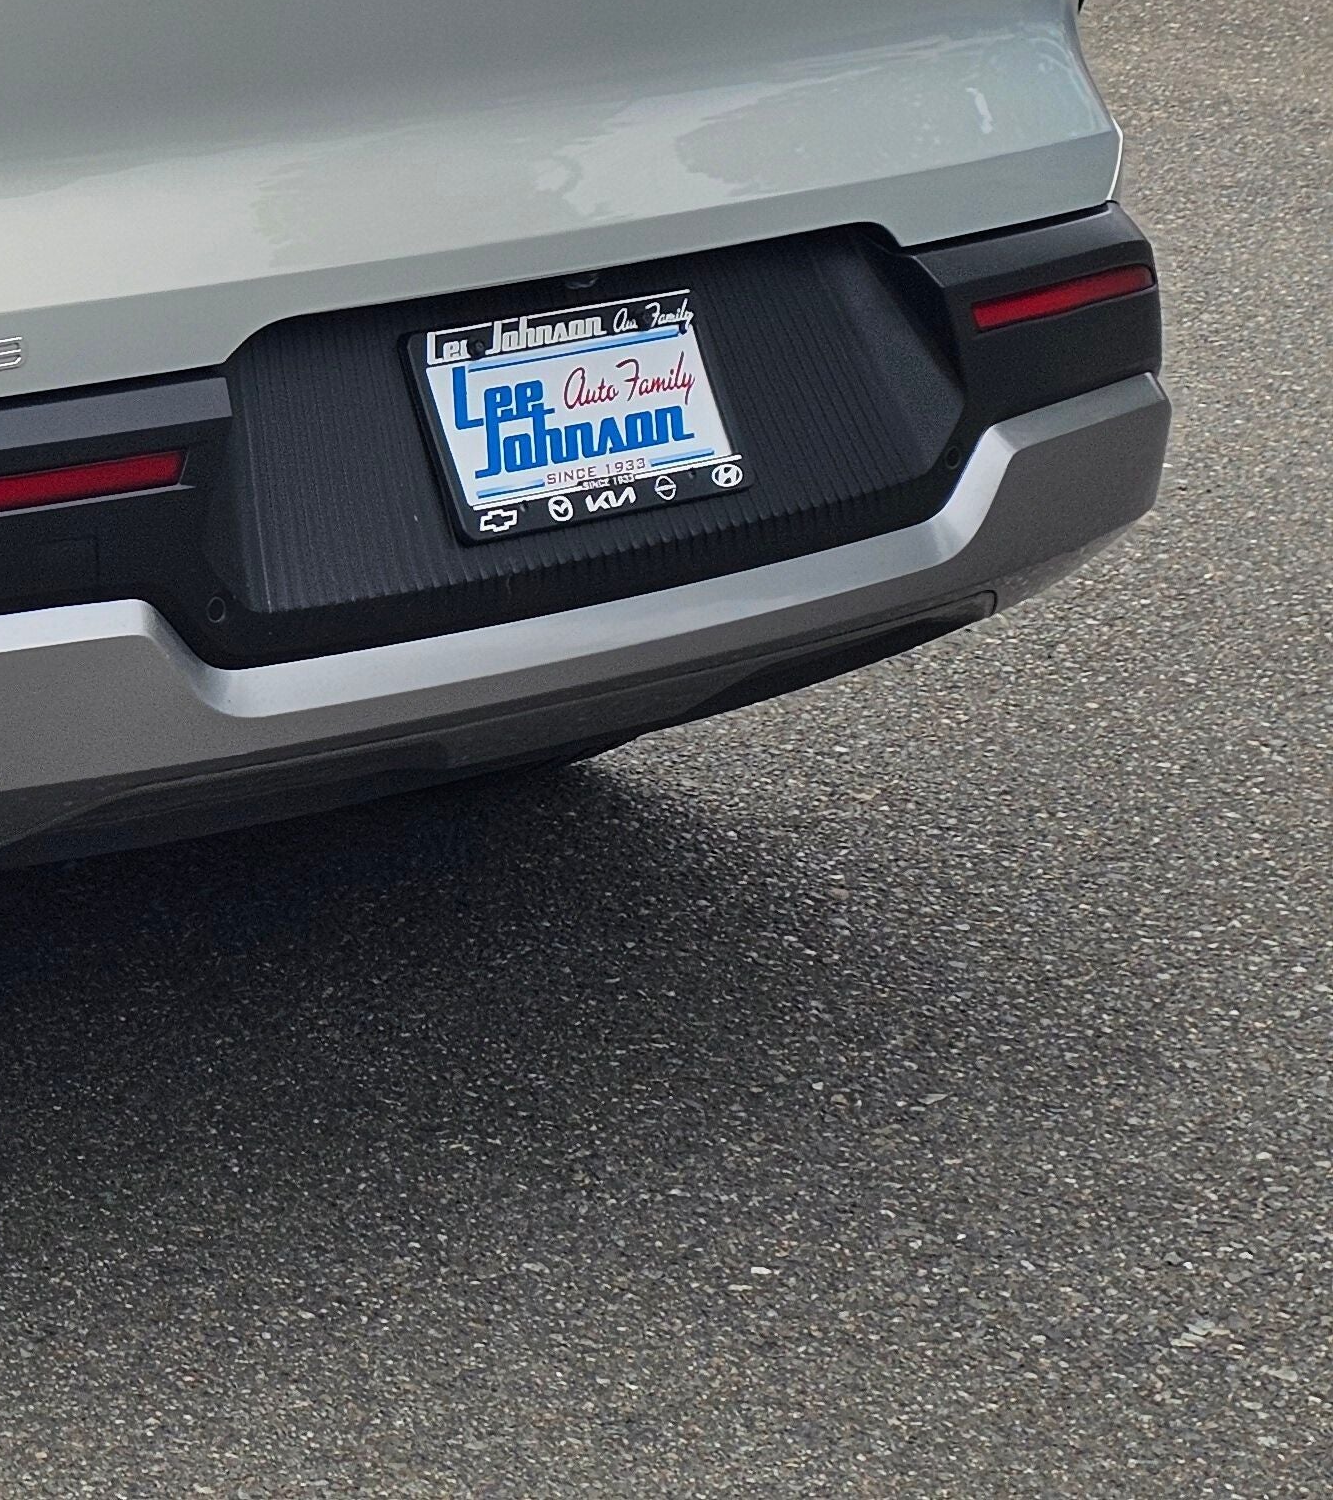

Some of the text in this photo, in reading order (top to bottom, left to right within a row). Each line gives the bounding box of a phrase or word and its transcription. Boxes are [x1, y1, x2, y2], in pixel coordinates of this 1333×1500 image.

[484, 315, 608, 356] Johnson
[644, 297, 695, 331] Family
[451, 365, 555, 431] Lee
[563, 350, 696, 410] Auto Family
[474, 402, 695, 480] Johnson
[546, 457, 646, 486] SINCE 1933
[585, 486, 637, 513] KIA
